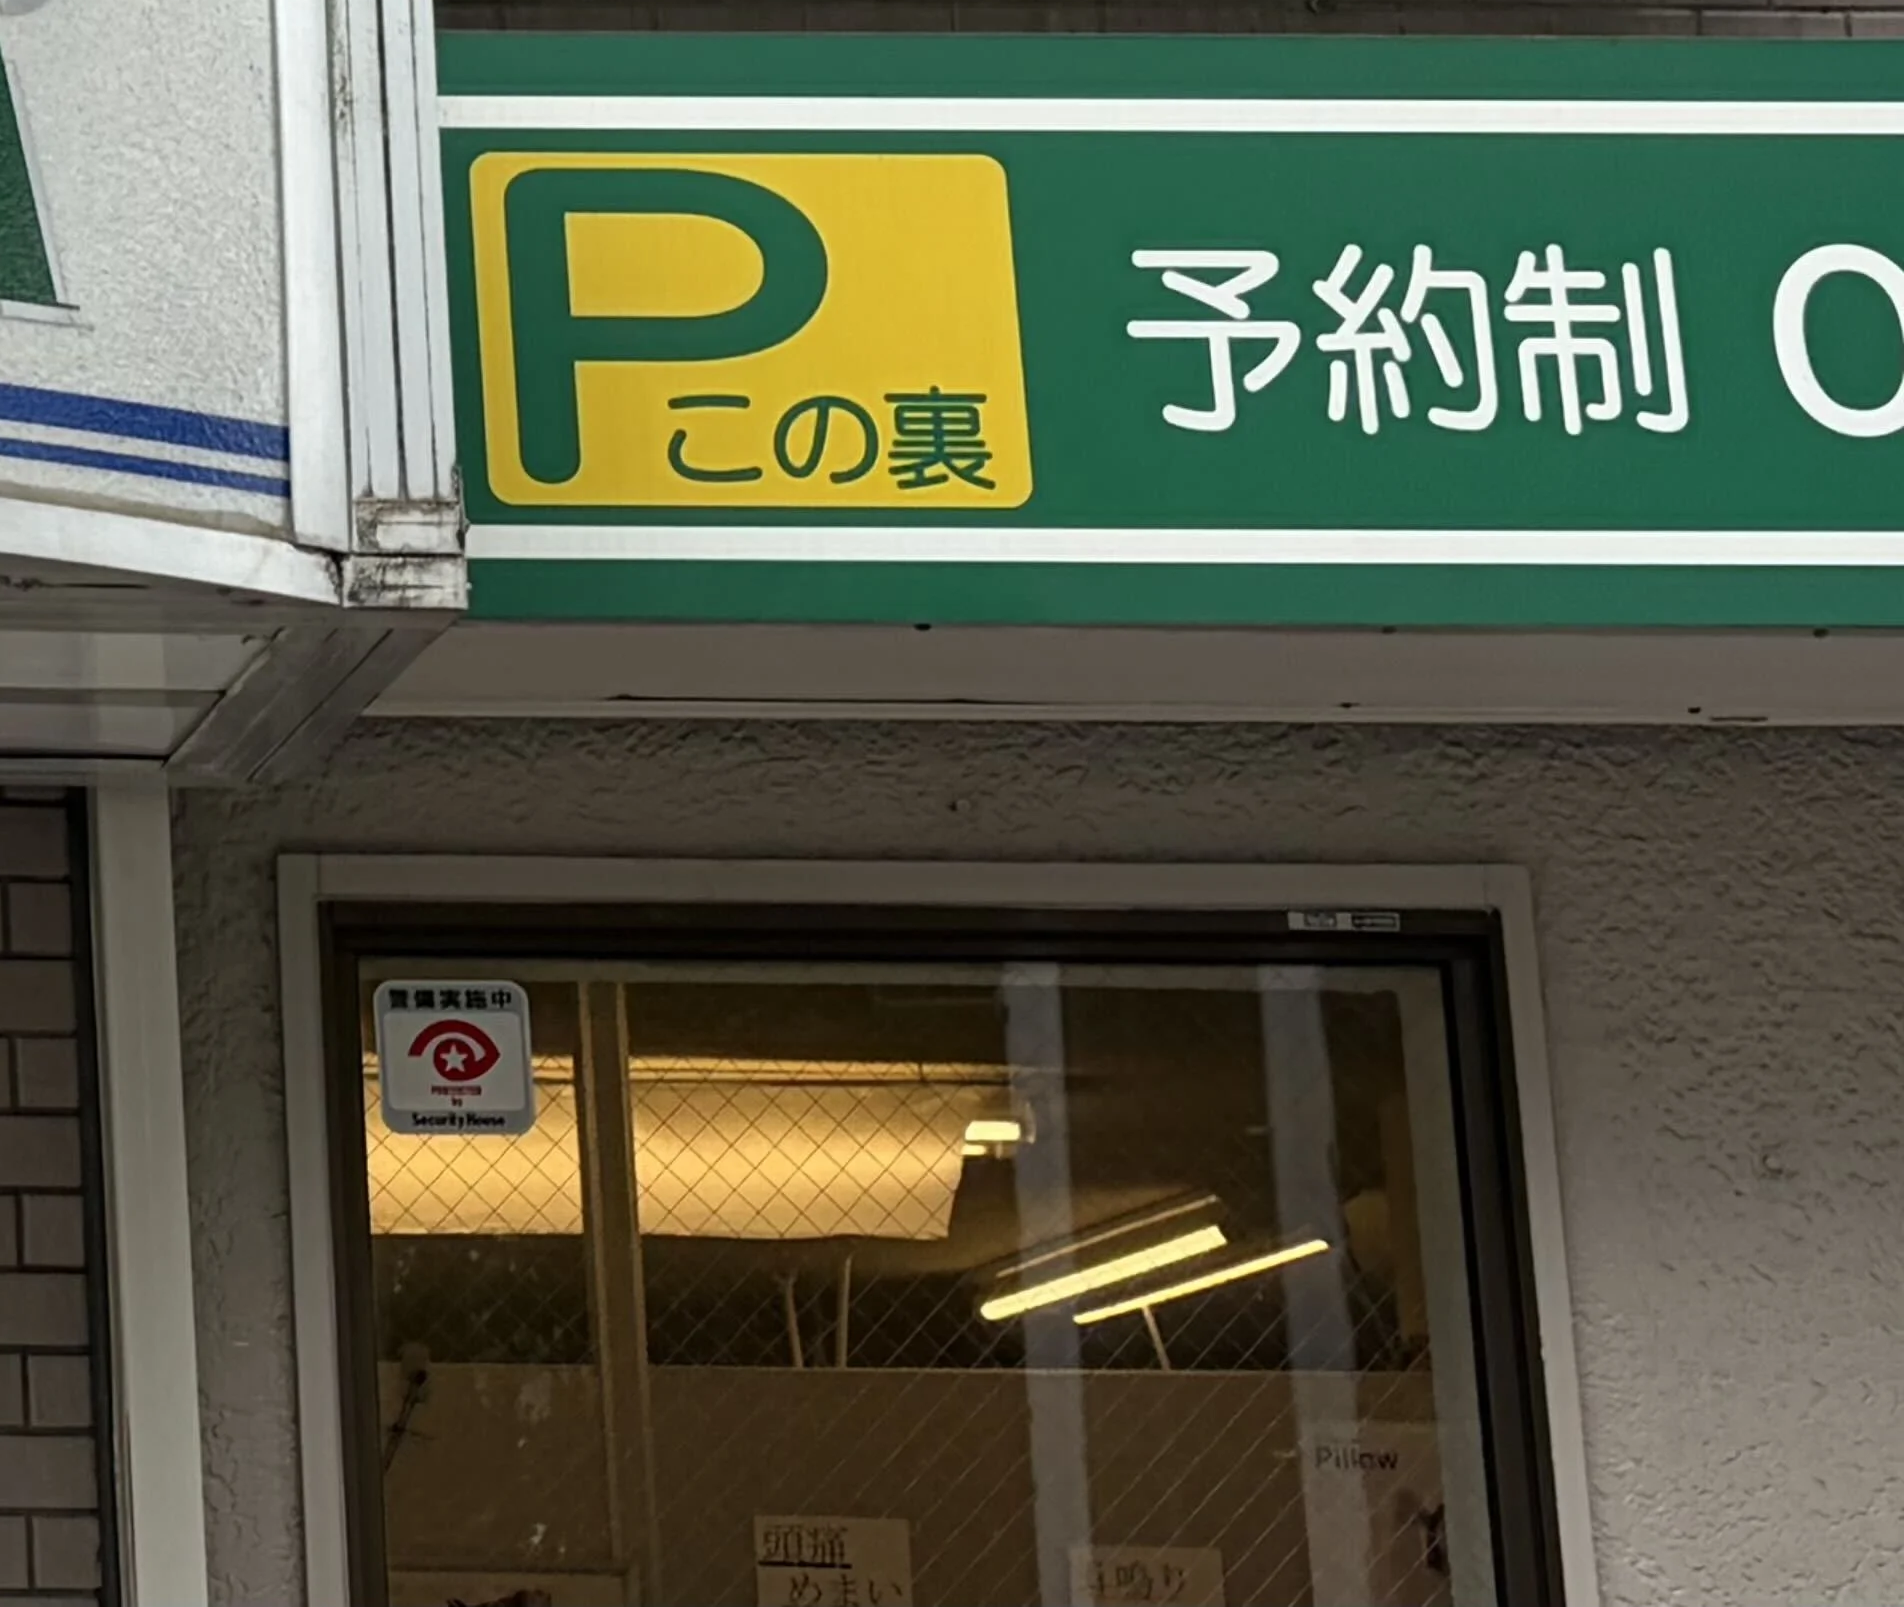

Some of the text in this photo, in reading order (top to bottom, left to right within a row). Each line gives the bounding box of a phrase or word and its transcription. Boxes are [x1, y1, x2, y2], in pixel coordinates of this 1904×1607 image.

[504, 168, 830, 485] P
[1126, 243, 1691, 436] 予約制
[668, 384, 998, 492] この裏
[412, 1112, 465, 1129] Security
[1315, 1445, 1398, 1470] Pillow
